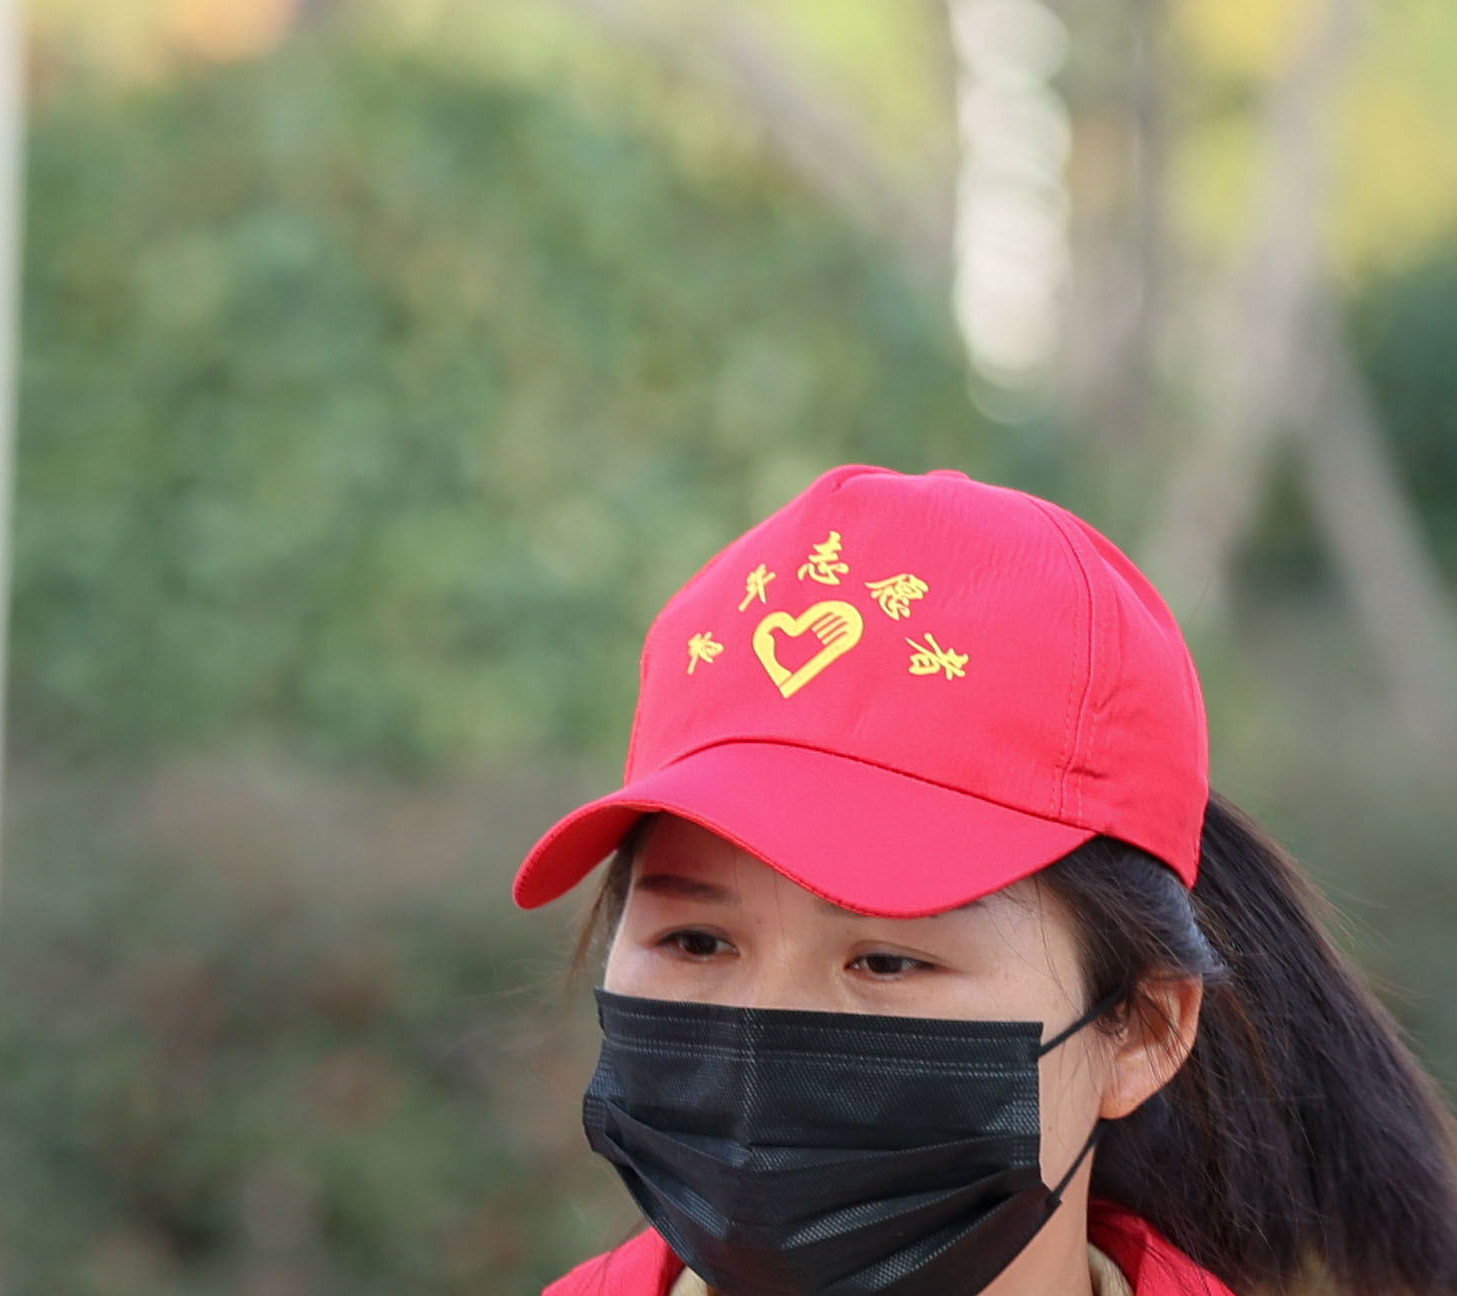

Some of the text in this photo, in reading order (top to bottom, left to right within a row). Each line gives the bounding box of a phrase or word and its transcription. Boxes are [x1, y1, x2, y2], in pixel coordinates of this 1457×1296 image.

[687, 531, 969, 680] 青年志愿者
